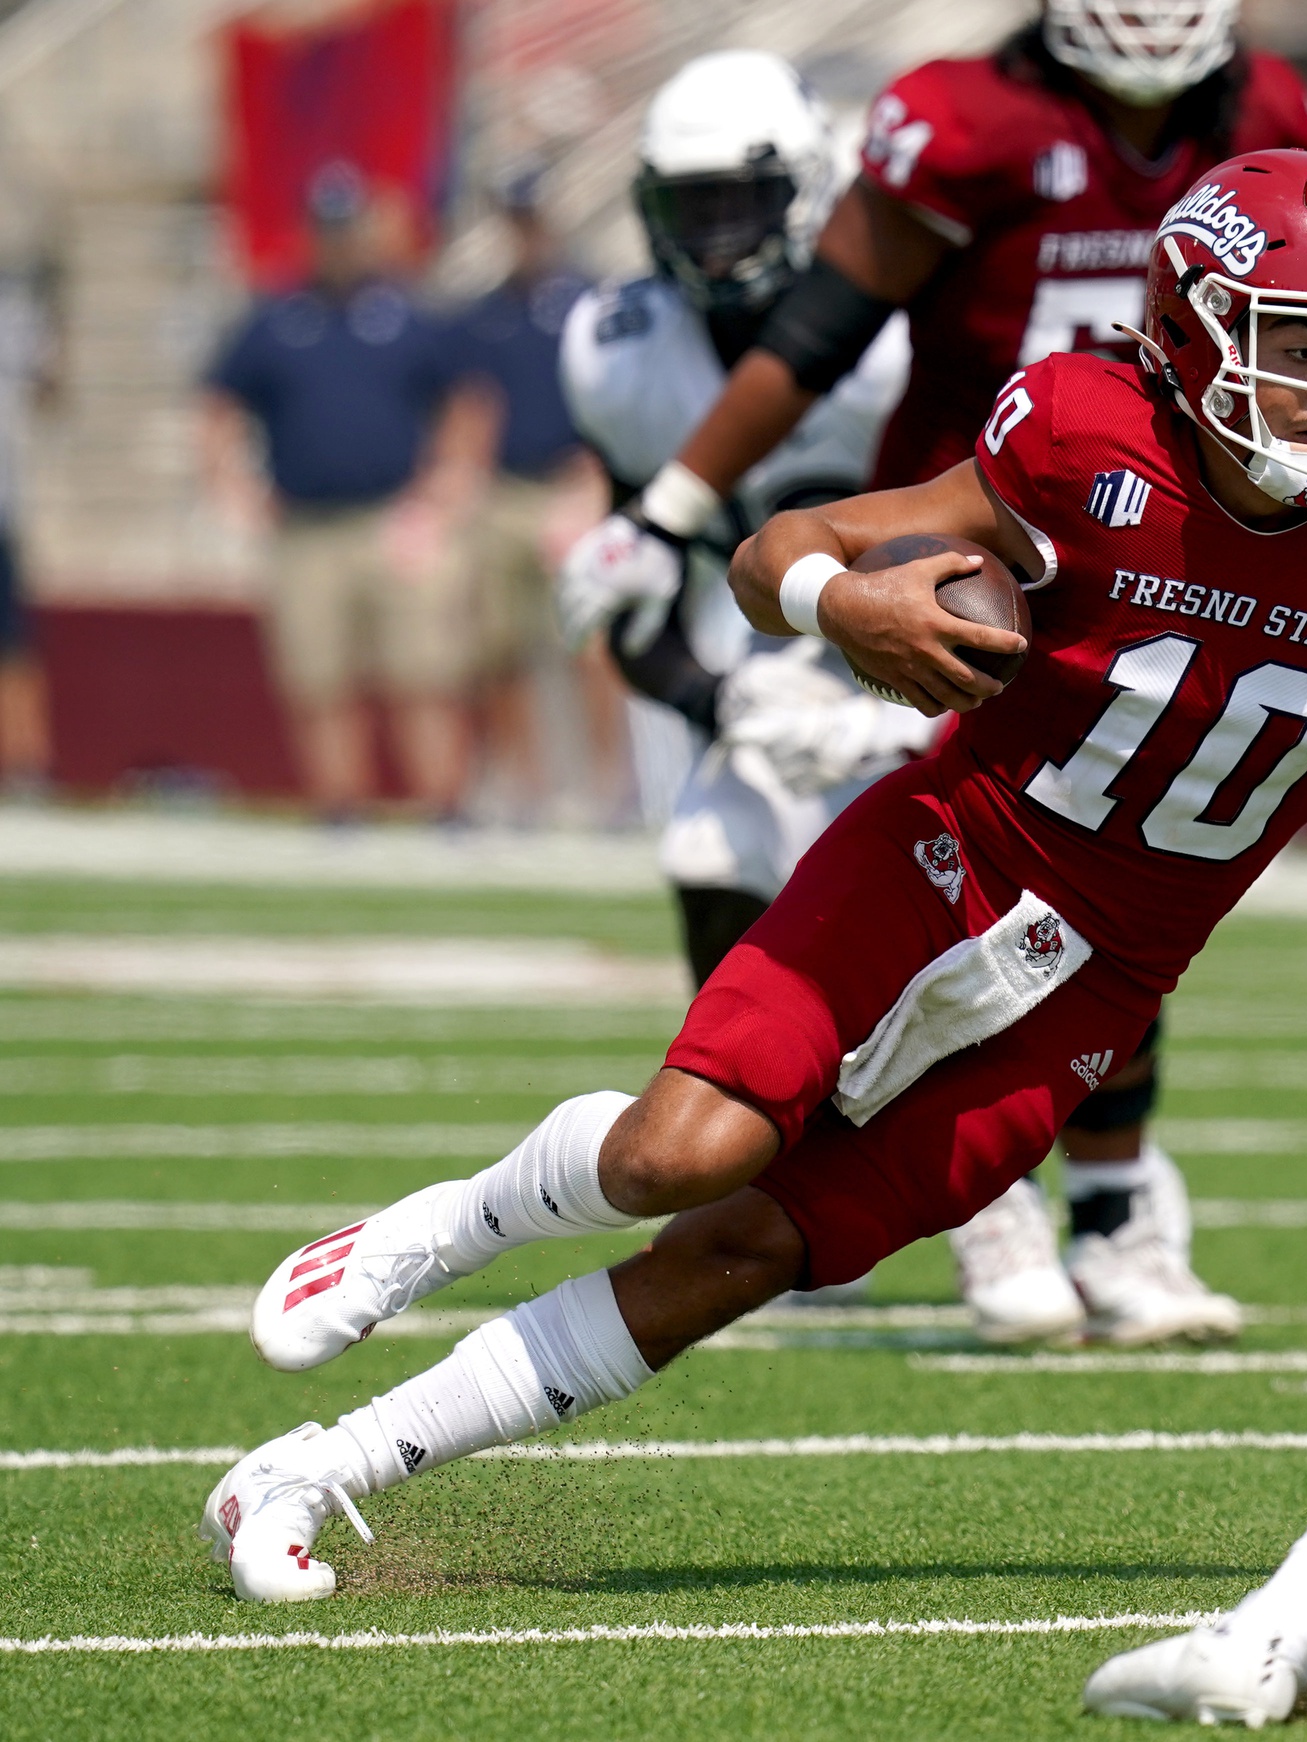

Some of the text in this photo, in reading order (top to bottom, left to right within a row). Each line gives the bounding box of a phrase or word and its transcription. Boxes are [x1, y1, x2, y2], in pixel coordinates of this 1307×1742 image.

[1160, 184, 1267, 276] ulldogs
[985, 371, 1035, 456] 10
[1108, 567, 1258, 628] FRESNO
[544, 1386, 565, 1417] adidas
[396, 1439, 416, 1474] adidas
